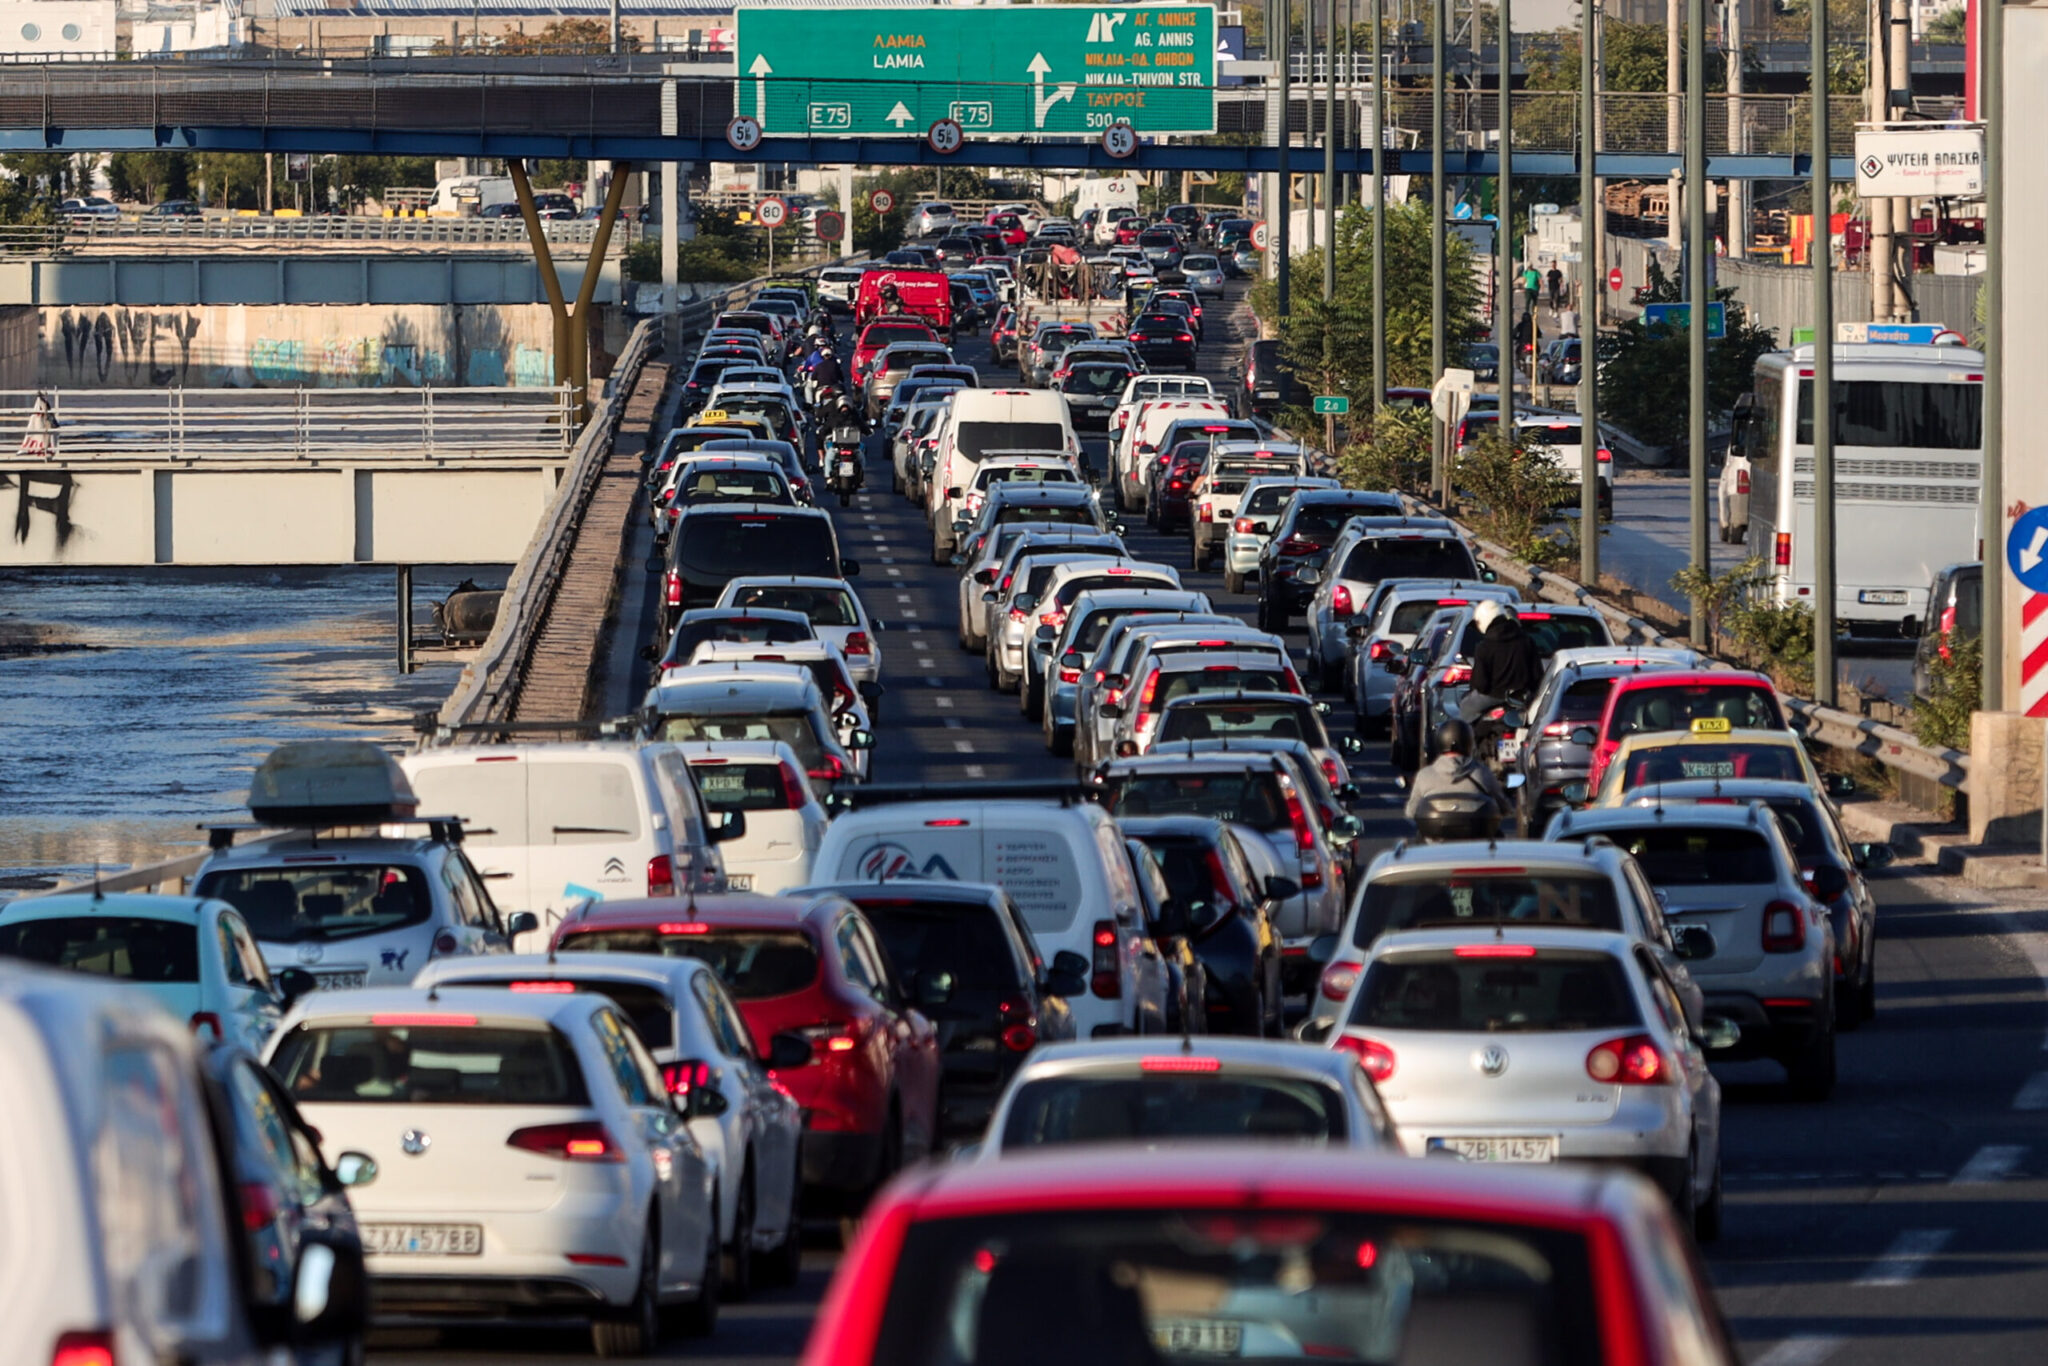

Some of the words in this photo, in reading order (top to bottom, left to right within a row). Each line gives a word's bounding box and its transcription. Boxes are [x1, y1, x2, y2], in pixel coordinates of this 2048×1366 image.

[1134, 13, 1152, 26] ΑΓ.
[1158, 12, 1197, 26] ΑΝΝΗΣ
[873, 35, 926, 48] ΛΑΜΙΑ
[1134, 32, 1153, 47] AG.
[1158, 32, 1194, 47] ANNIS
[873, 54, 925, 68] LAMIA
[1155, 52, 1194, 66] ΘΗΒΩΝ
[1085, 72, 1174, 86] NIKAIA-THIVON
[1178, 72, 1204, 86] STR.
[1086, 93, 1146, 107] ΤΑΥΡΟΣ
[812, 107, 823, 123] E
[827, 107, 847, 123] 75
[953, 107, 965, 122] E
[968, 106, 988, 122] 75
[1086, 112, 1113, 127] 500
[737, 126, 744, 140] 5
[938, 129, 945, 143] 5
[1112, 133, 1119, 147] 5
[762, 206, 781, 218] 80
[1699, 720, 1723, 730] TAXI
[1499, 1141, 1548, 1161] 1457
